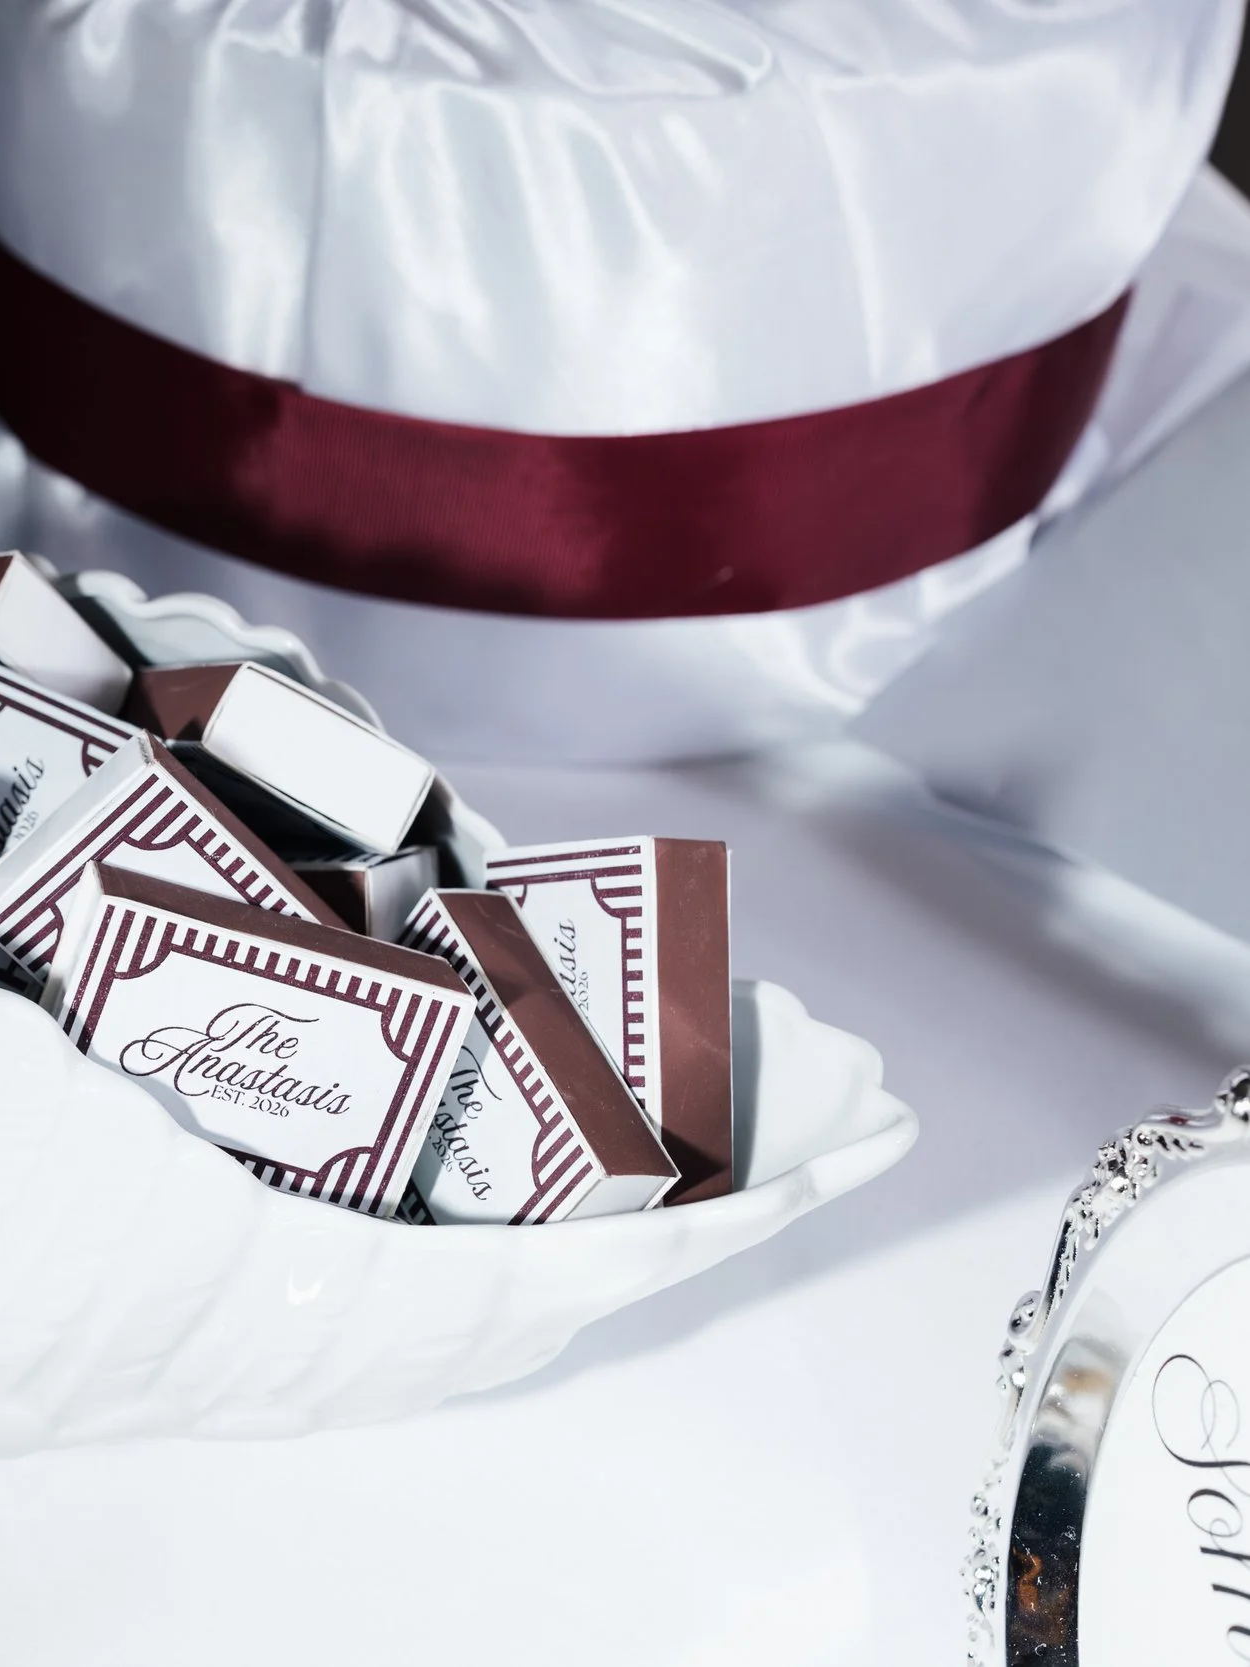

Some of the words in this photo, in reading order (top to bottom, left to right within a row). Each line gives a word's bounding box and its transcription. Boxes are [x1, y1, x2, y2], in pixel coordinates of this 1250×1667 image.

[206, 1003, 319, 1059] The
[119, 1026, 352, 1115] Anastasis
[210, 1084, 245, 1106] EST.
[248, 1096, 290, 1118] 2026
[432, 1136, 453, 1173] 2026
[433, 1102, 492, 1200] stasis
